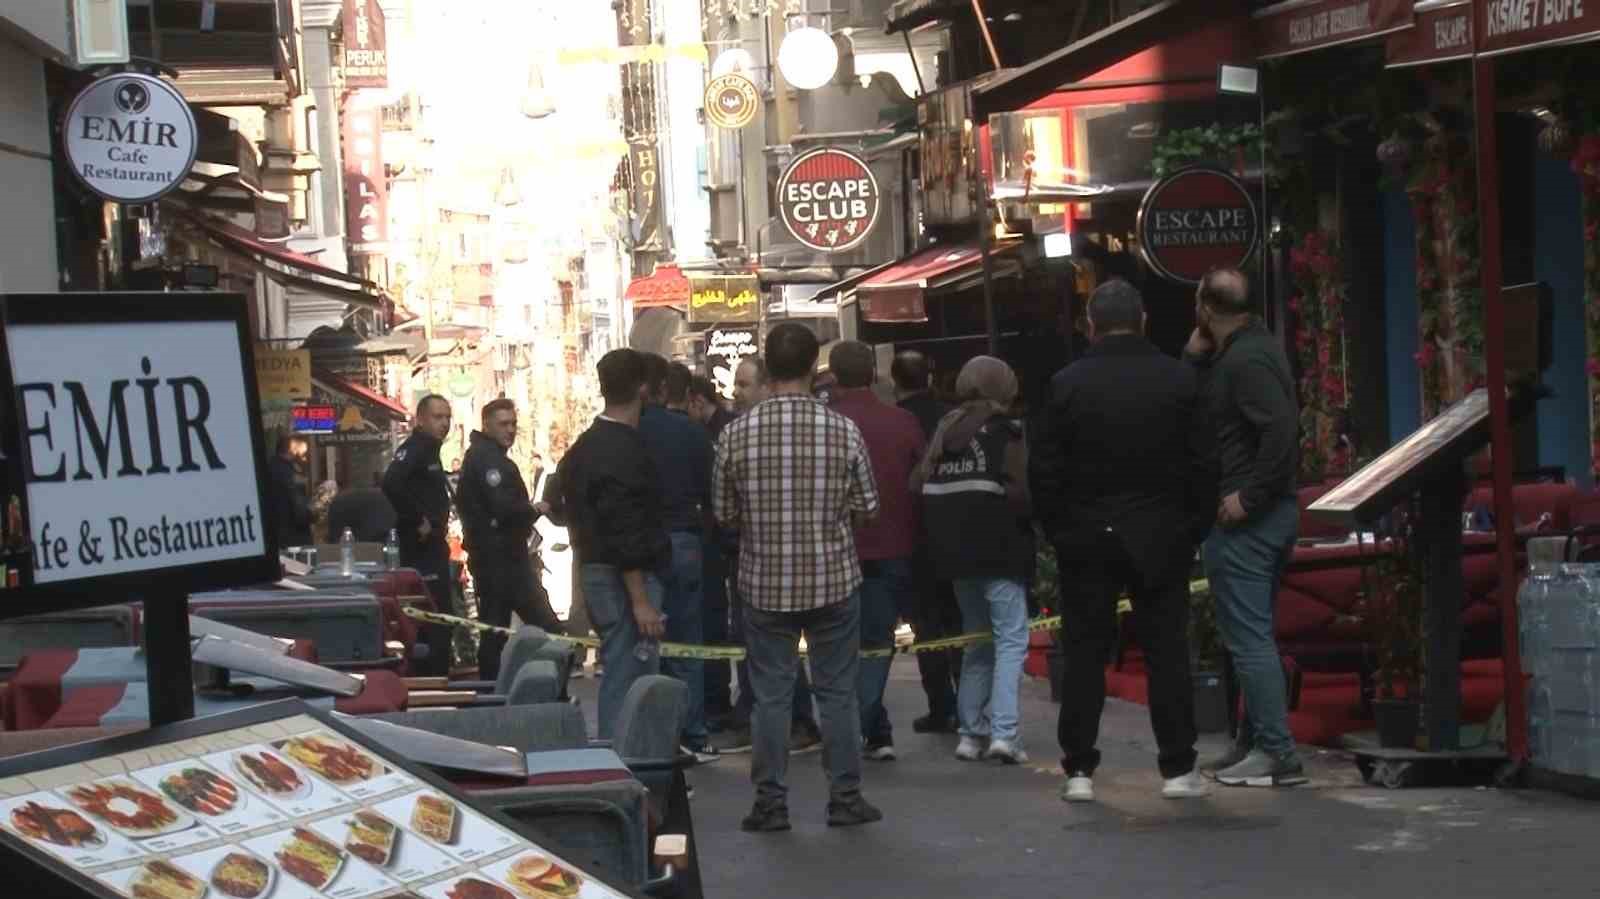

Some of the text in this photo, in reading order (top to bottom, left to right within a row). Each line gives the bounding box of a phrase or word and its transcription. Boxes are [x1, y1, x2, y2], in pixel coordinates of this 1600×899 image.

[80, 115, 179, 148] EMİR
[107, 146, 148, 164] Cafe
[82, 163, 173, 183] Restaurant
[787, 178, 870, 202] ESCAPE
[792, 199, 868, 222] CLUB
[1154, 207, 1247, 230] ESCAPE
[1153, 229, 1249, 246] RESTAURANT
[78, 519, 105, 566] &
[109, 503, 257, 561] Restaurant
